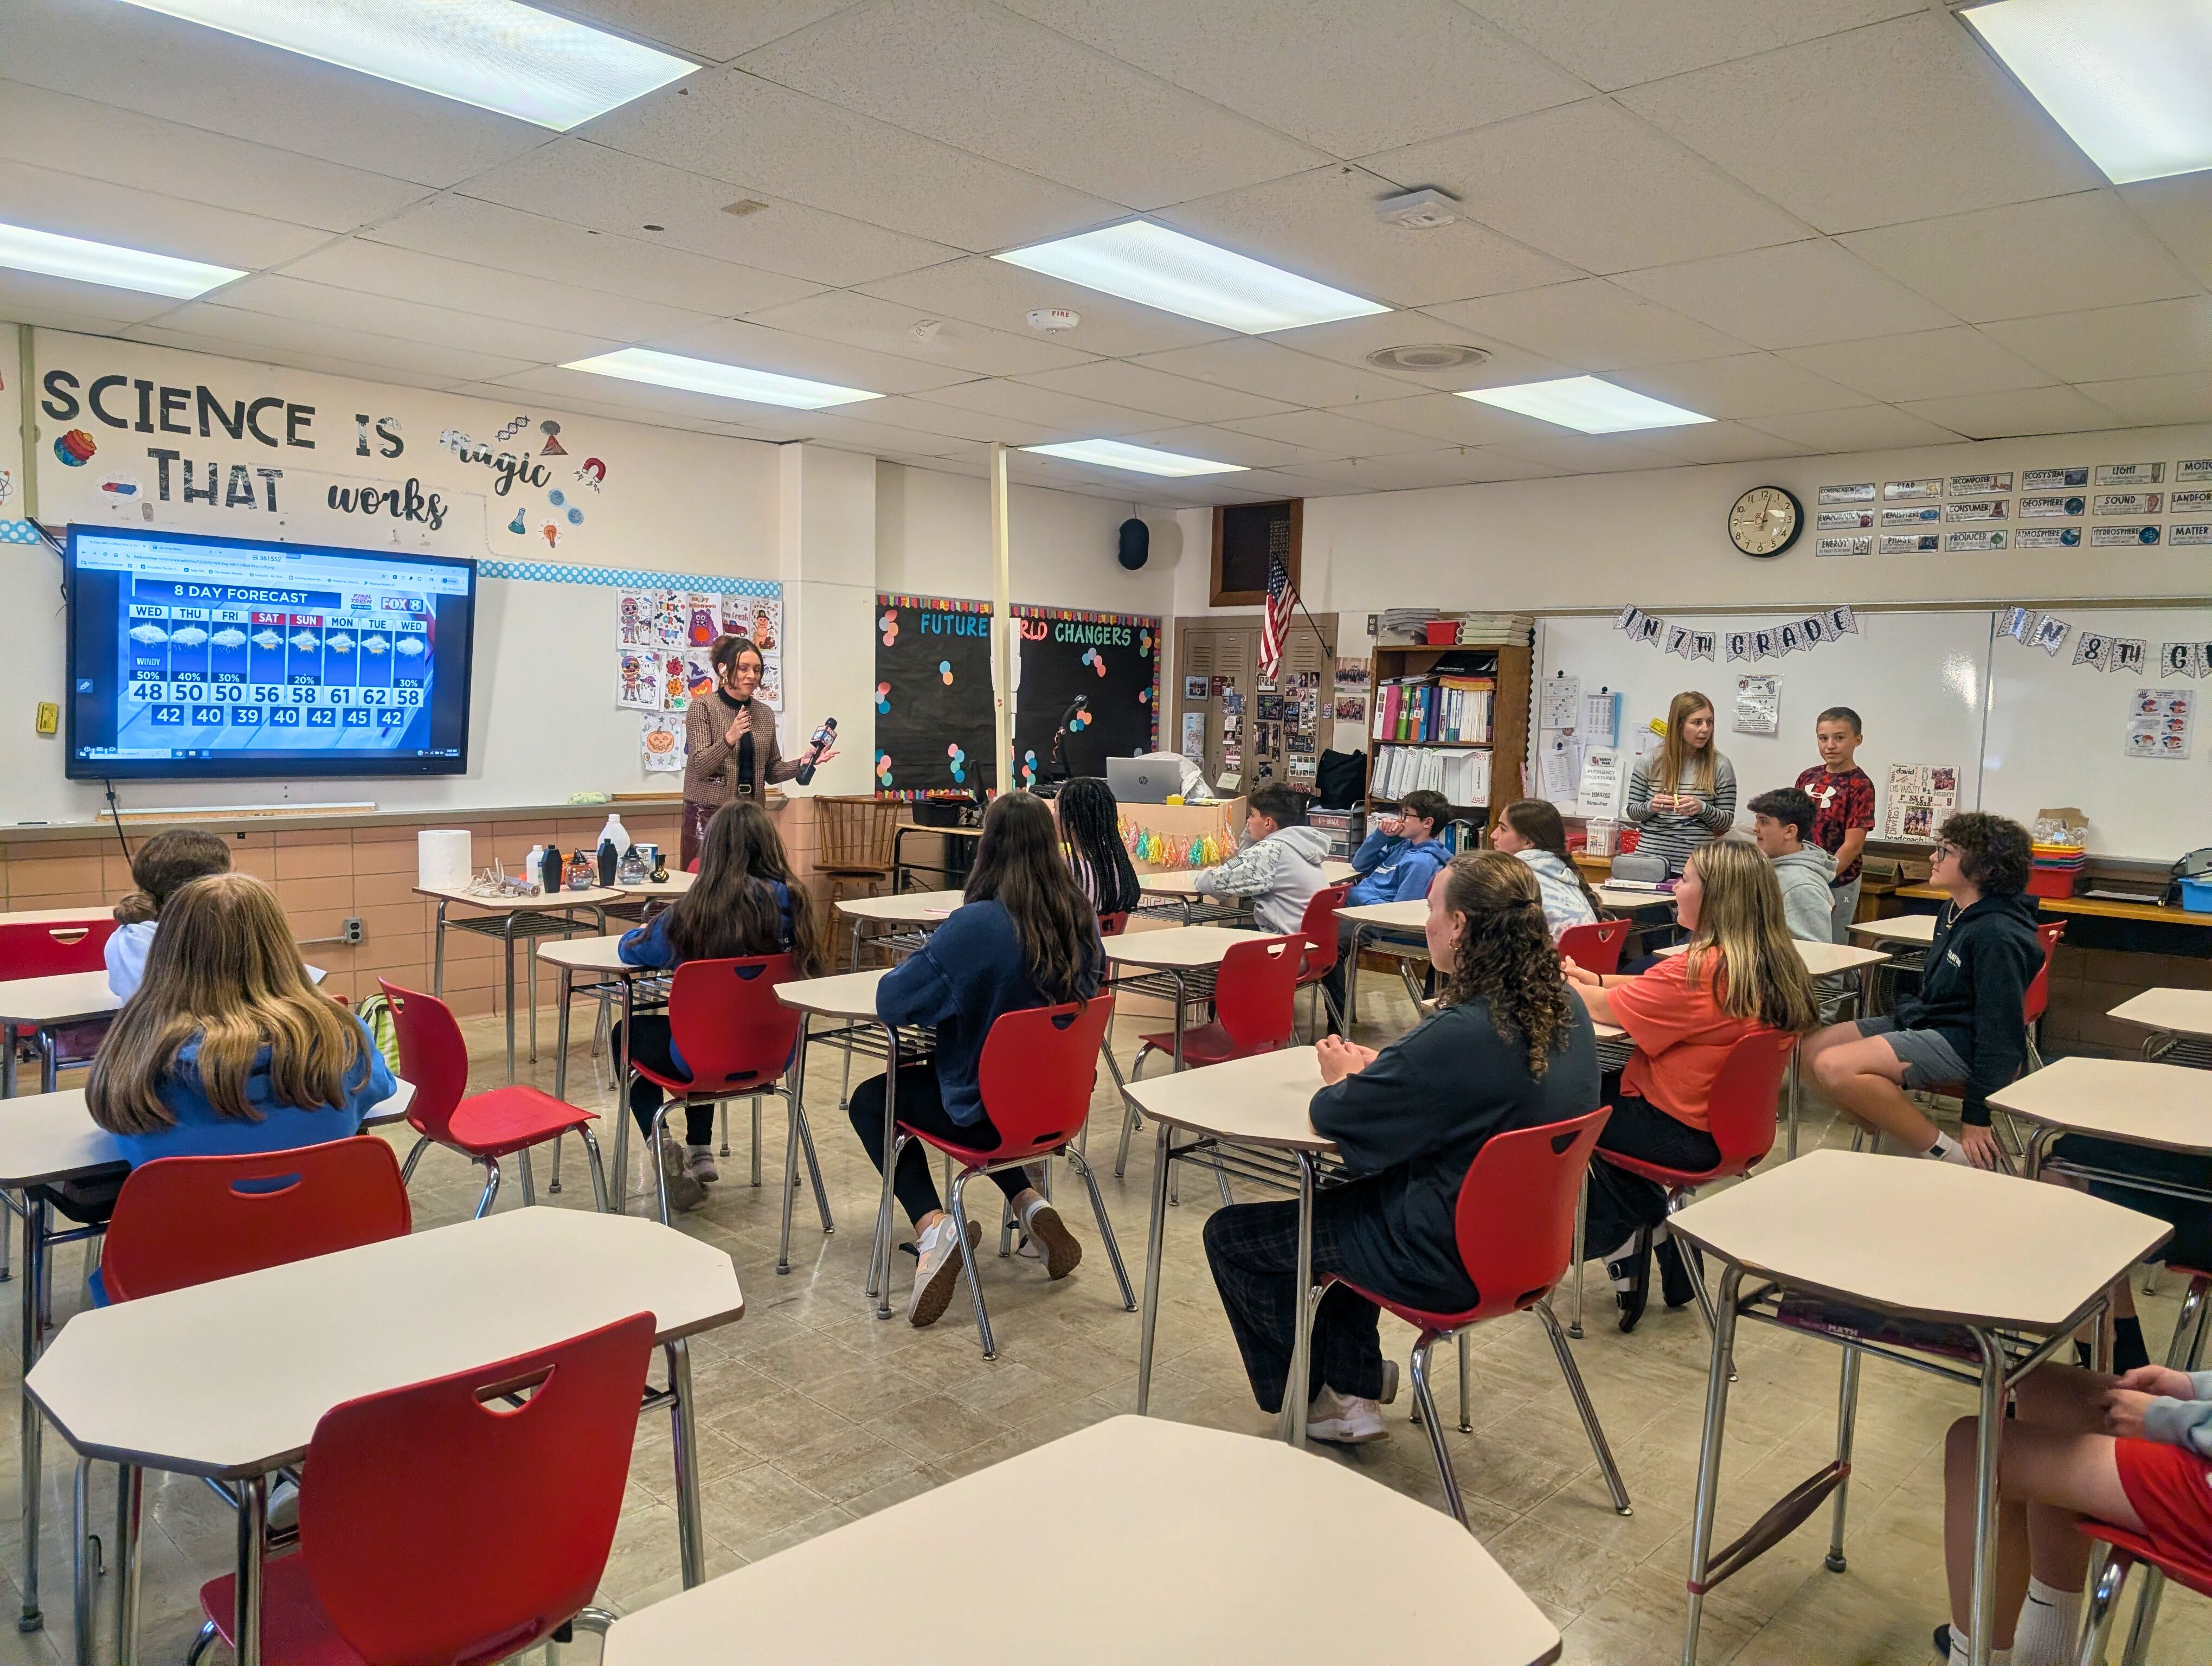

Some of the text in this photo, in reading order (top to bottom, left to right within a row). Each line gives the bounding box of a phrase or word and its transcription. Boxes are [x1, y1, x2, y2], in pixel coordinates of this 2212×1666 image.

[41, 370, 551, 496] SCIENCE IS magic
[2025, 470, 2064, 479] ECOSYSTEM
[2112, 465, 2136, 475] LIGHT
[1952, 476, 1990, 485] DECOMPOSER
[147, 447, 448, 531] THAT works
[2022, 498, 2063, 507] GEOSPHERE
[2105, 496, 2136, 504] SOUND
[1949, 503, 1989, 512] CONSUMER
[1883, 510, 1920, 518] HEMISPHERE
[1734, 518, 1739, 527] 9
[1787, 516, 1792, 524] 3
[1780, 529, 1786, 537] 4
[2017, 530, 2060, 538] ATMOSPHERE
[2175, 526, 2208, 535] MATTER
[1735, 532, 1741, 540] 8
[1950, 533, 1987, 541] PRODUCER
[1757, 544, 1763, 552] 6
[1822, 538, 1849, 548] ENERGY
[174, 585, 308, 604] 8 DAY FORECAST
[382, 597, 421, 611] FOX 8
[659, 601, 679, 612] TRICK
[136, 606, 162, 617] WED
[179, 608, 201, 619] THU
[222, 611, 238, 621] FRI
[259, 613, 279, 623] SAT
[296, 615, 317, 625] SUN
[331, 617, 353, 627] MON
[663, 616, 673, 625] OR
[369, 619, 387, 629] TUE
[401, 621, 422, 630] WED
[657, 627, 679, 639] TREAT
[921, 613, 1131, 646] FUTURE RLD CHANGERS
[1625, 608, 1847, 655] IN 7TH GRADE
[2011, 608, 2063, 642] IN
[2085, 638, 2141, 663] 8TH
[136, 657, 161, 666] WINDY
[137, 671, 159, 680] 50%
[177, 672, 201, 682] 40%
[218, 674, 240, 682] 30%
[294, 676, 314, 684] 20%
[400, 679, 418, 687] 30%
[133, 683, 163, 701] 48
[175, 684, 203, 701] 50
[215, 685, 242, 702] 50
[254, 686, 279, 703] 56
[292, 688, 316, 704] 58
[330, 688, 350, 704] 61
[363, 689, 385, 704] 62
[397, 690, 419, 706] 58
[157, 708, 181, 722] 42
[196, 708, 221, 722] 40
[237, 709, 259, 723] 39
[274, 710, 297, 723] 40
[311, 711, 332, 724] 42
[348, 711, 367, 724] 45
[382, 712, 401, 725] 42
[1889, 784, 1899, 792] CHS
[1900, 785, 1920, 794] VARSITY
[1932, 789, 1954, 797] Team
